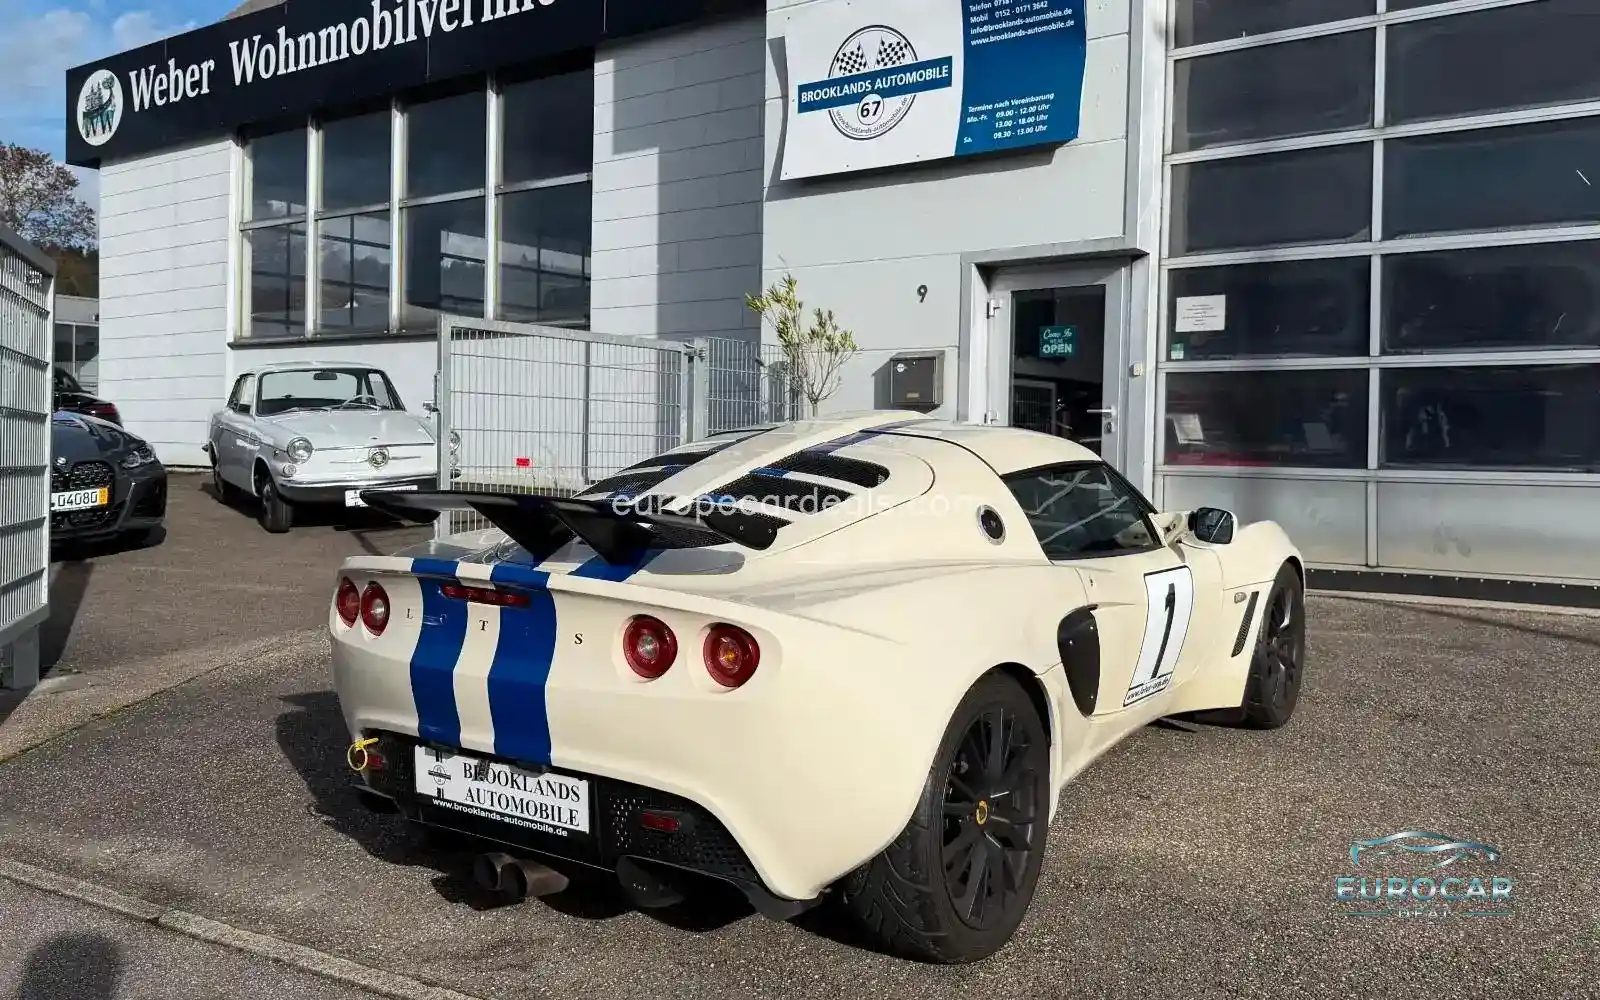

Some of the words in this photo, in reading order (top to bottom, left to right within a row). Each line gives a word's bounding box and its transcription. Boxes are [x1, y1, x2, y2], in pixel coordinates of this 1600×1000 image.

[969, 2, 991, 12] Telefon
[970, 14, 988, 23] Mobil
[995, 10, 1011, 18] 0152
[1016, 6, 1031, 14] 0171
[970, 8, 1072, 34] info@brooklands-automobile.de
[971, 20, 1074, 46] www.brooklands-automobile.de
[129, 58, 215, 112] Weber
[801, 80, 871, 103] BROOKLANDS
[874, 65, 949, 89] AUTOMOBILE
[860, 100, 881, 118] 67
[968, 104, 993, 113] Termine
[1011, 92, 1055, 106] Vereinbarung
[996, 110, 1014, 118] 09.00
[1038, 103, 1051, 111] Uhr
[1036, 114, 1048, 122] Uhr
[1035, 125, 1048, 133] Uhr
[916, 284, 928, 303] 9
[1042, 343, 1073, 354] OPEN
[1150, 582, 1176, 680] 1
[465, 786, 580, 827] AUTOMOBILE
[432, 798, 568, 837] www.brooklands-automobile.de
